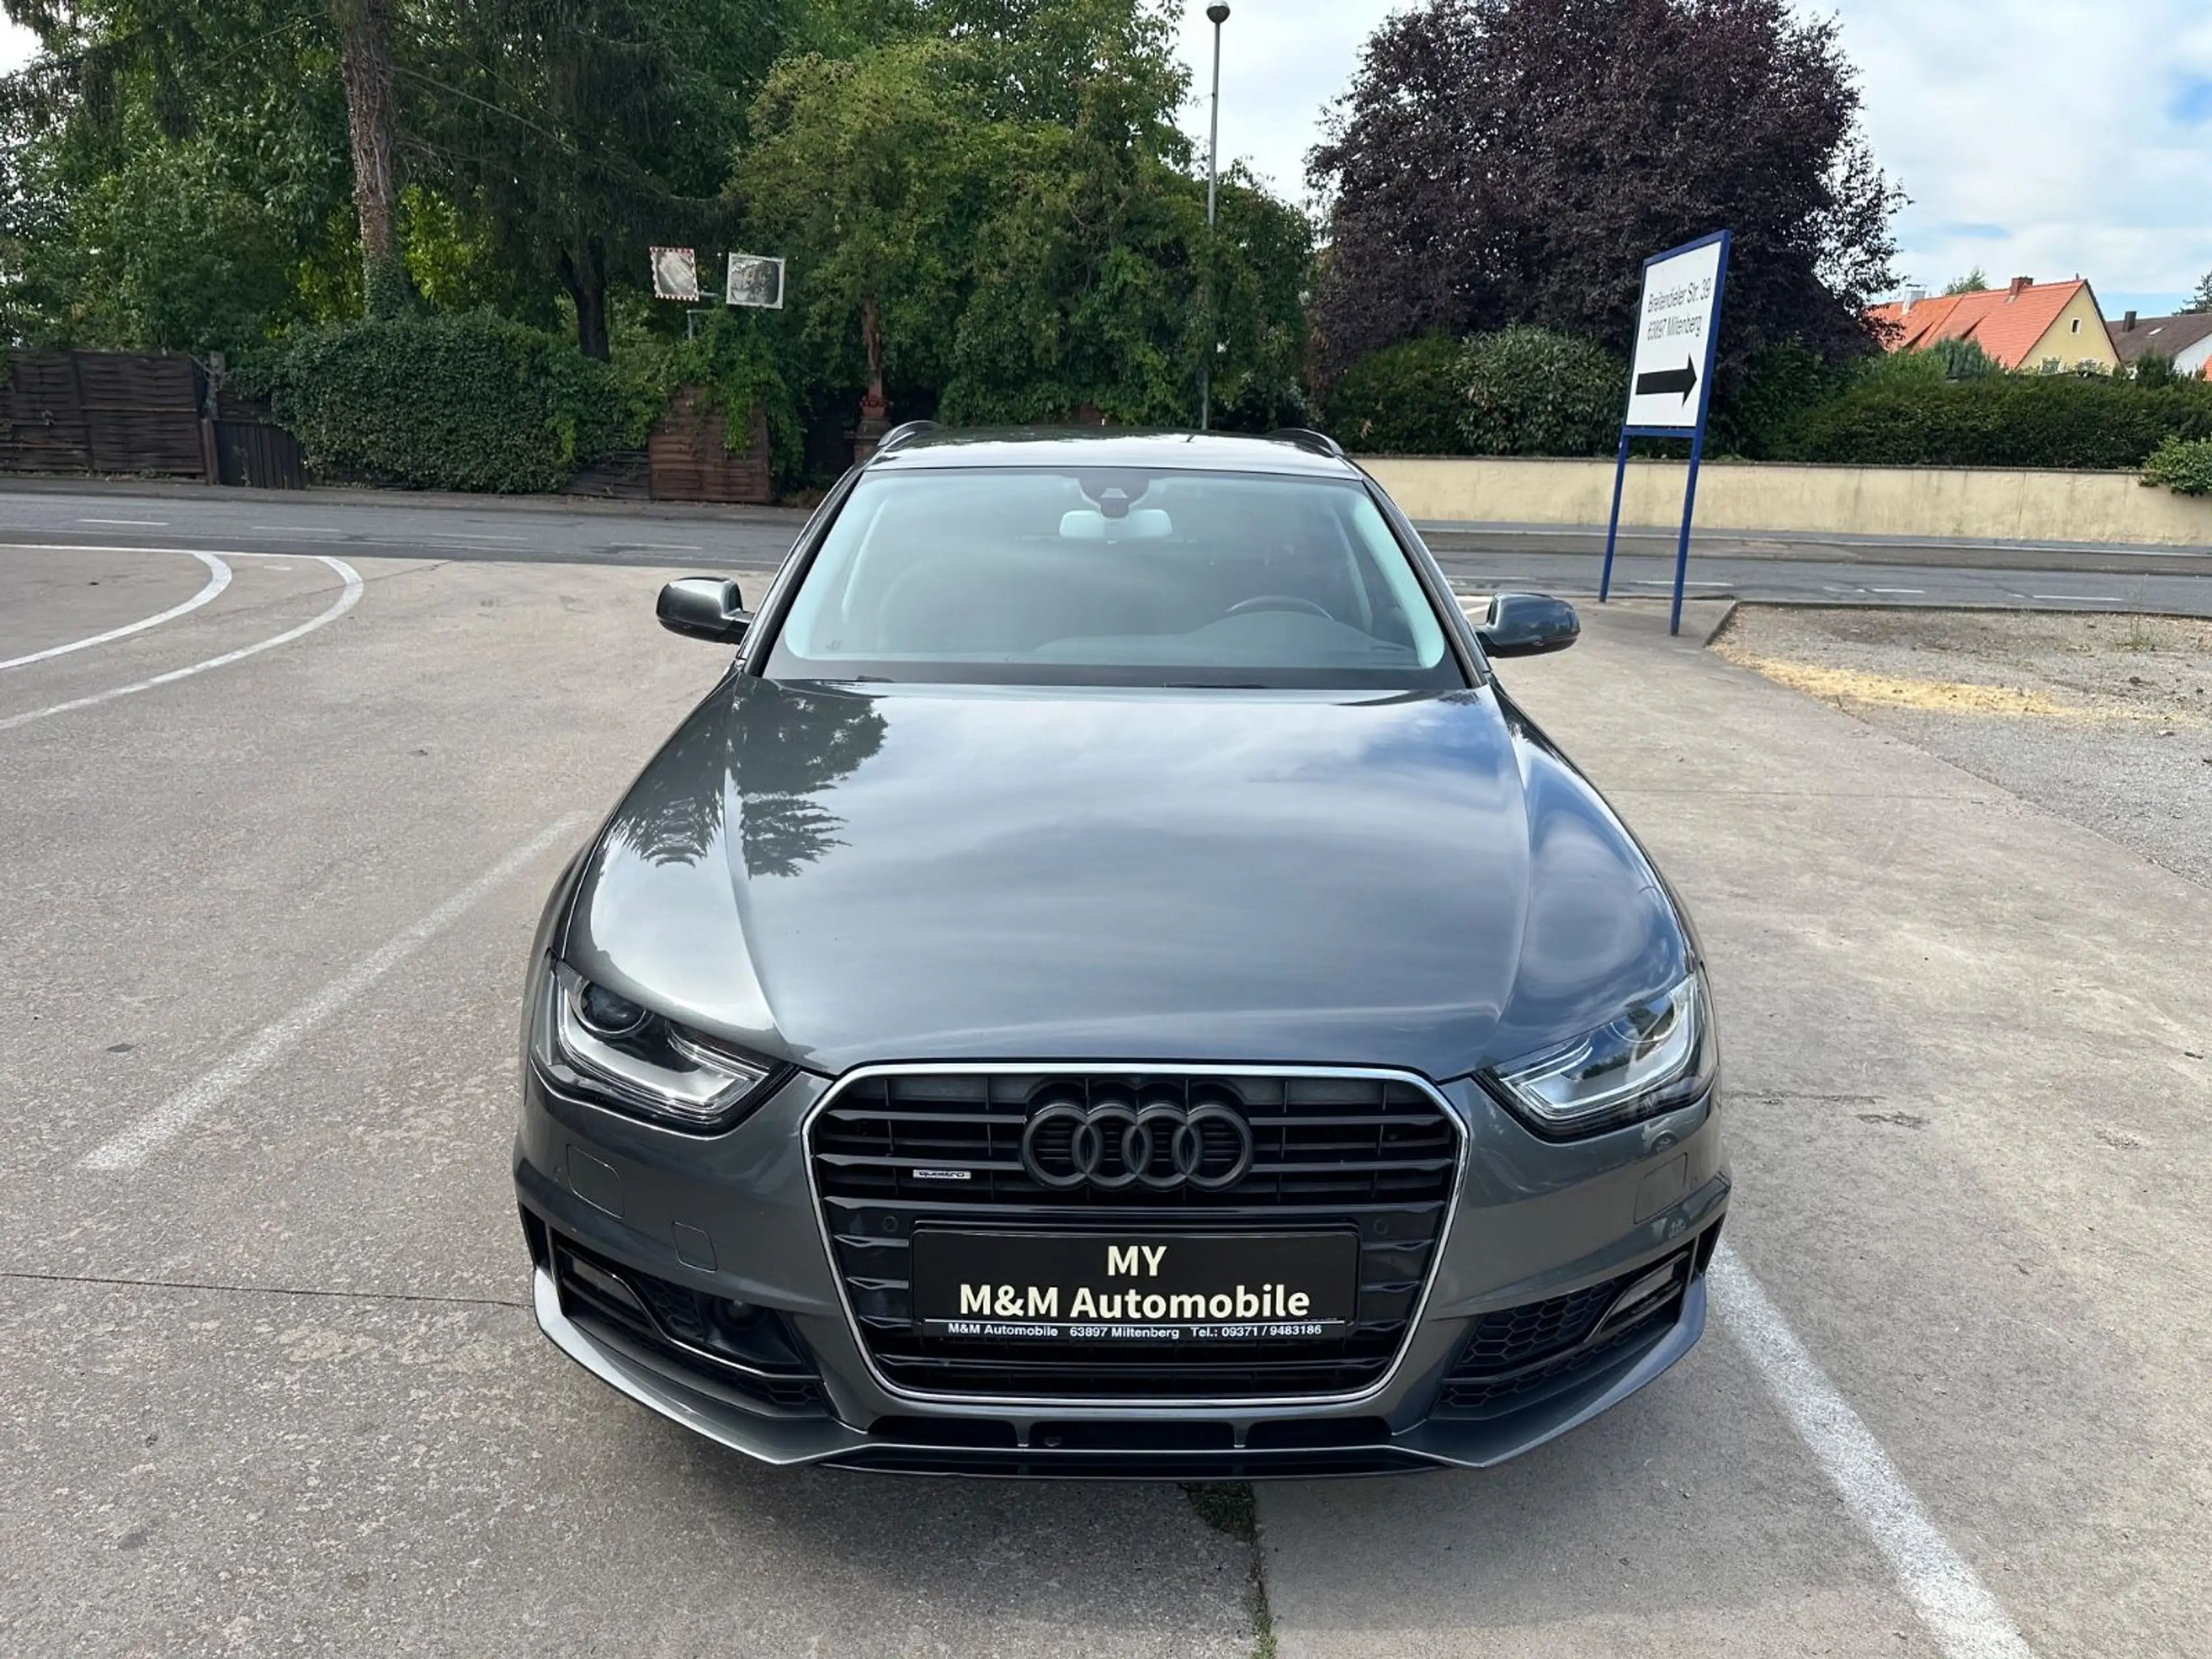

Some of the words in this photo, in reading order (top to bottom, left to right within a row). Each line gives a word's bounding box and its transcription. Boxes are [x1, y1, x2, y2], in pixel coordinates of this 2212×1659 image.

[1108, 1245, 1167, 1277] MY
[960, 1283, 1059, 1317] M&M
[1070, 1283, 1310, 1319] Automobile
[948, 1323, 980, 1334] M&M
[984, 1324, 1058, 1337] Automobile
[1070, 1327, 1107, 1337] 63897
[1111, 1327, 1180, 1339] Miltenberg
[1191, 1327, 1218, 1337] Tel.:
[1222, 1326, 1257, 1336] 09371
[1270, 1324, 1322, 1336] 9483186
